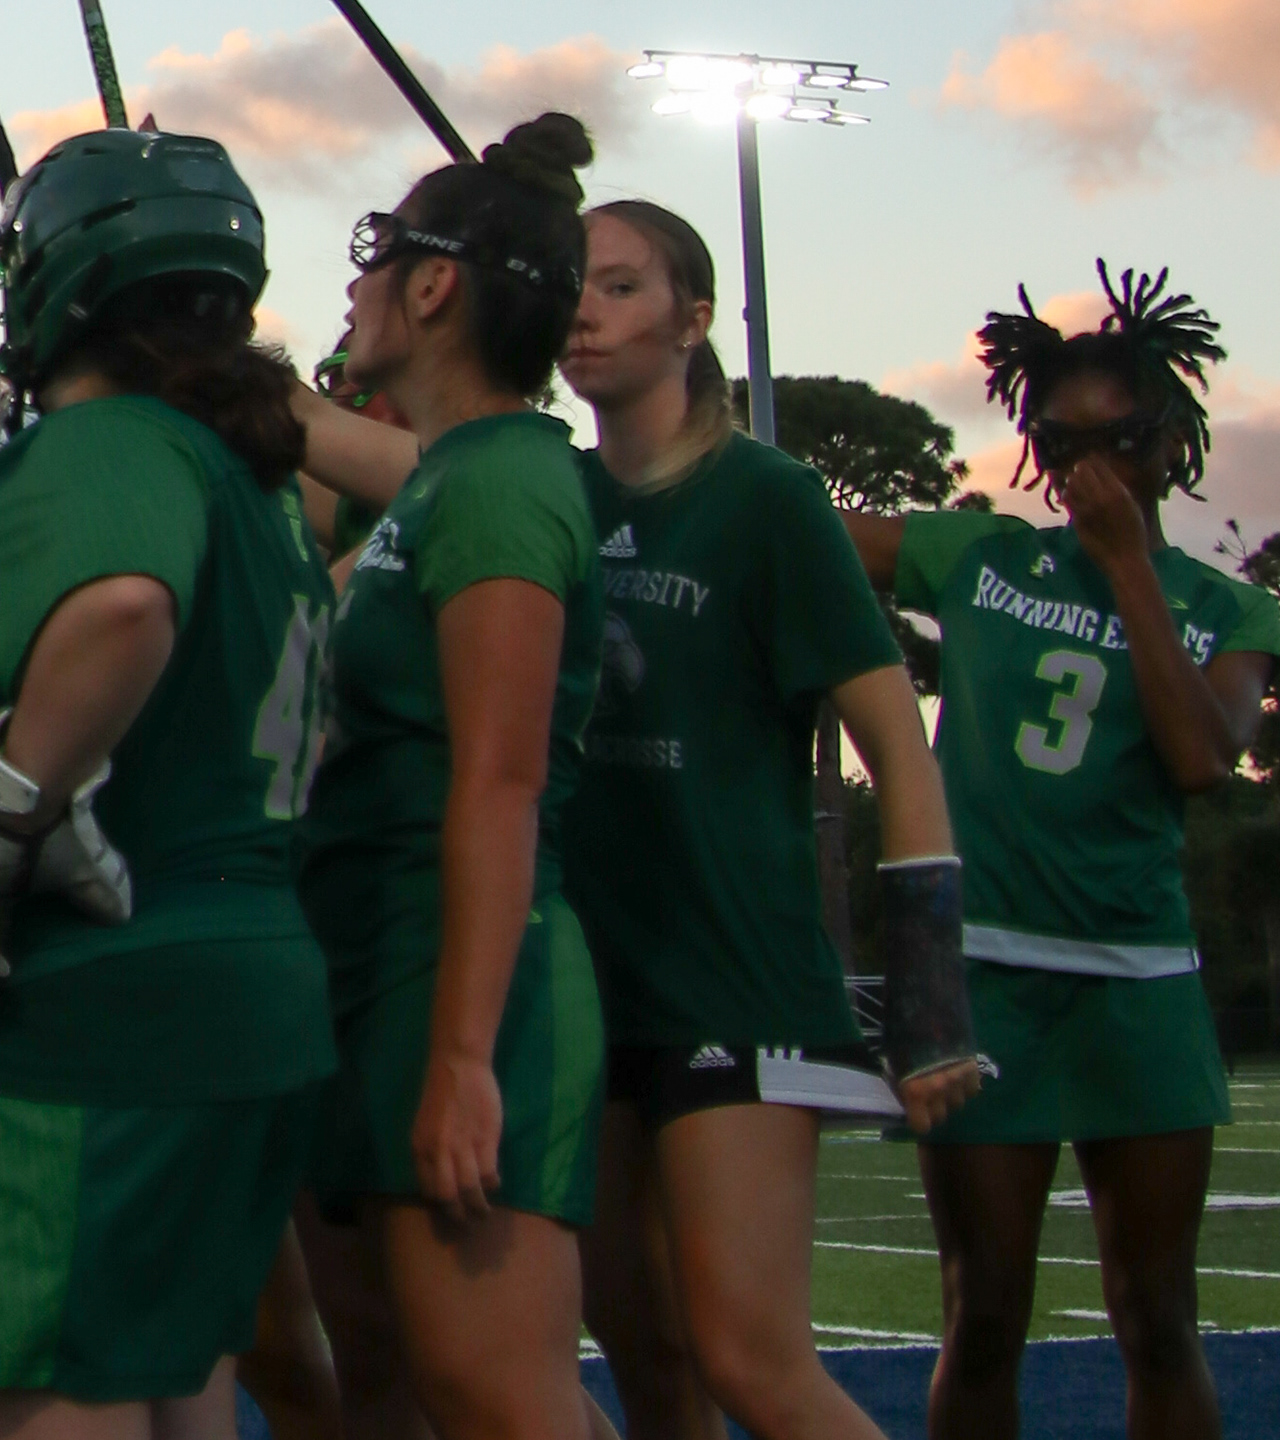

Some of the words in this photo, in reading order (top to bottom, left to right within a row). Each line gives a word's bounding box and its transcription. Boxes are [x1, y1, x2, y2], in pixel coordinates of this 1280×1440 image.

[405, 229, 466, 254] RINE
[597, 545, 638, 558] adidas
[601, 567, 711, 618] VERSITY
[971, 563, 1101, 643] RUNNING
[1098, 614, 1216, 667] EES
[1013, 648, 1109, 777] 3
[688, 1056, 736, 1069] adidas
